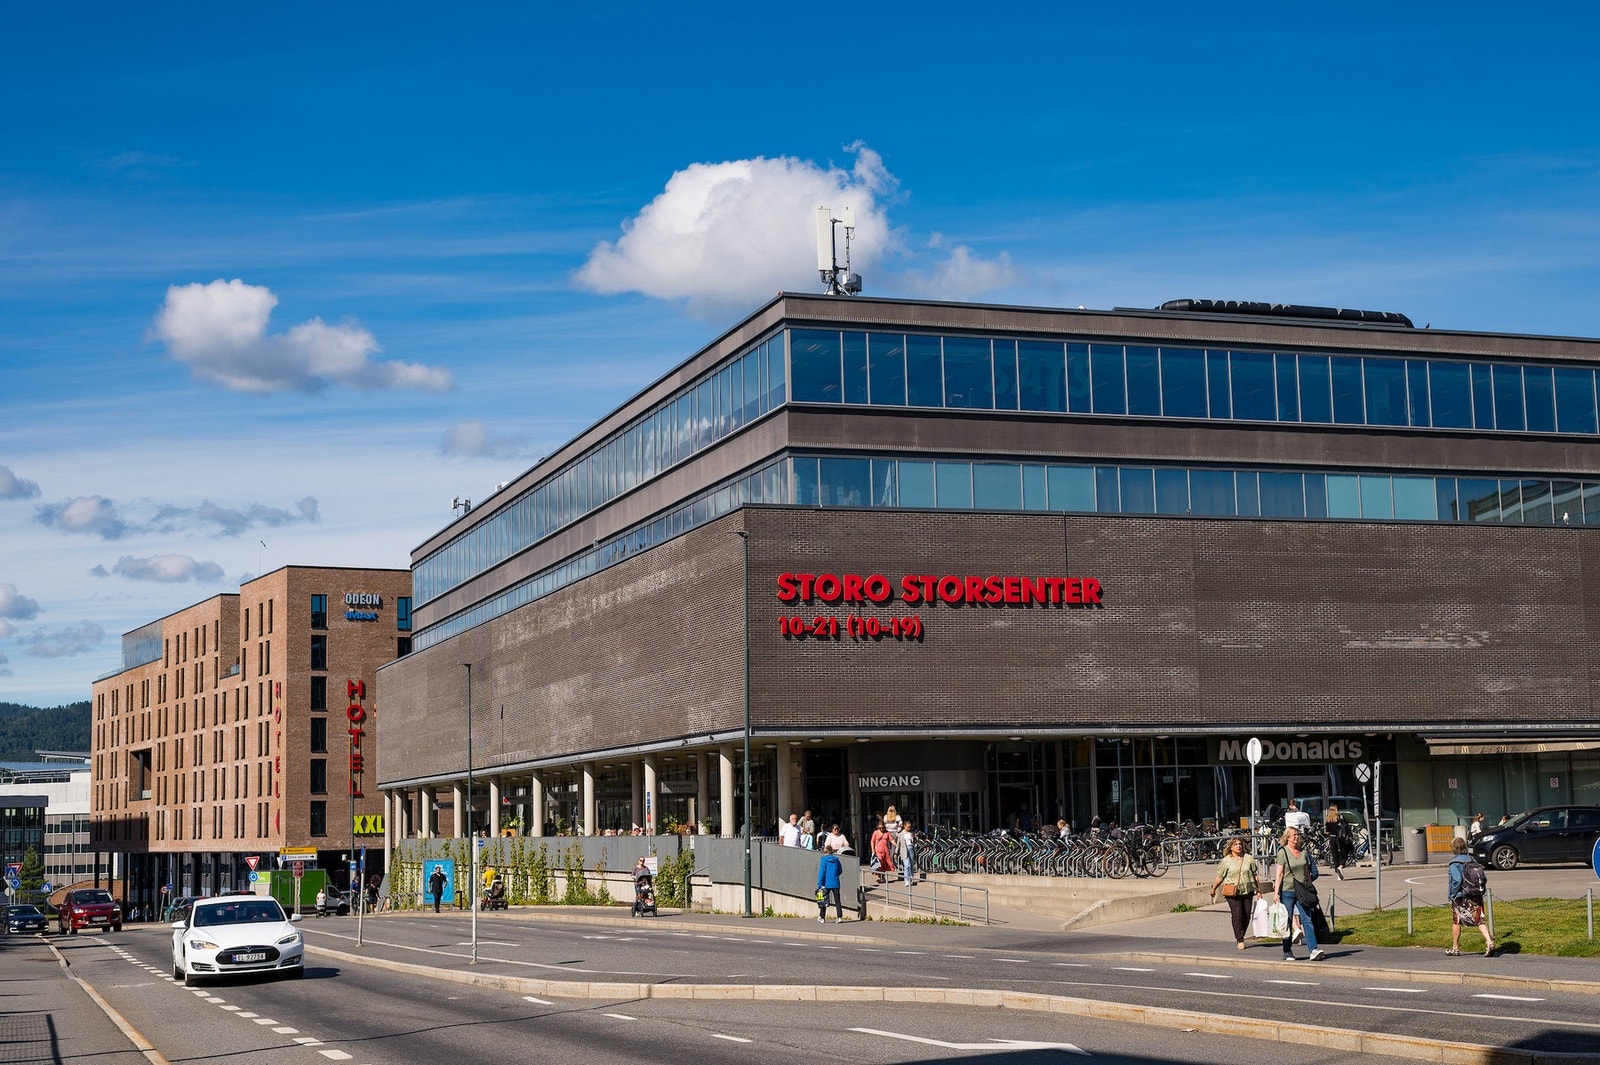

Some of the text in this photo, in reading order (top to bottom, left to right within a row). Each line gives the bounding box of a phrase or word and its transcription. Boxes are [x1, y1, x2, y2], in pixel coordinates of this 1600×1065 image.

[777, 572, 1101, 604] STORO STORSENTER
[345, 593, 380, 605] ODEON
[778, 614, 922, 638] 10-21 (10-19)
[346, 680, 364, 796] HOTEL
[859, 775, 920, 788] INNGANG
[353, 815, 385, 834] XXL
